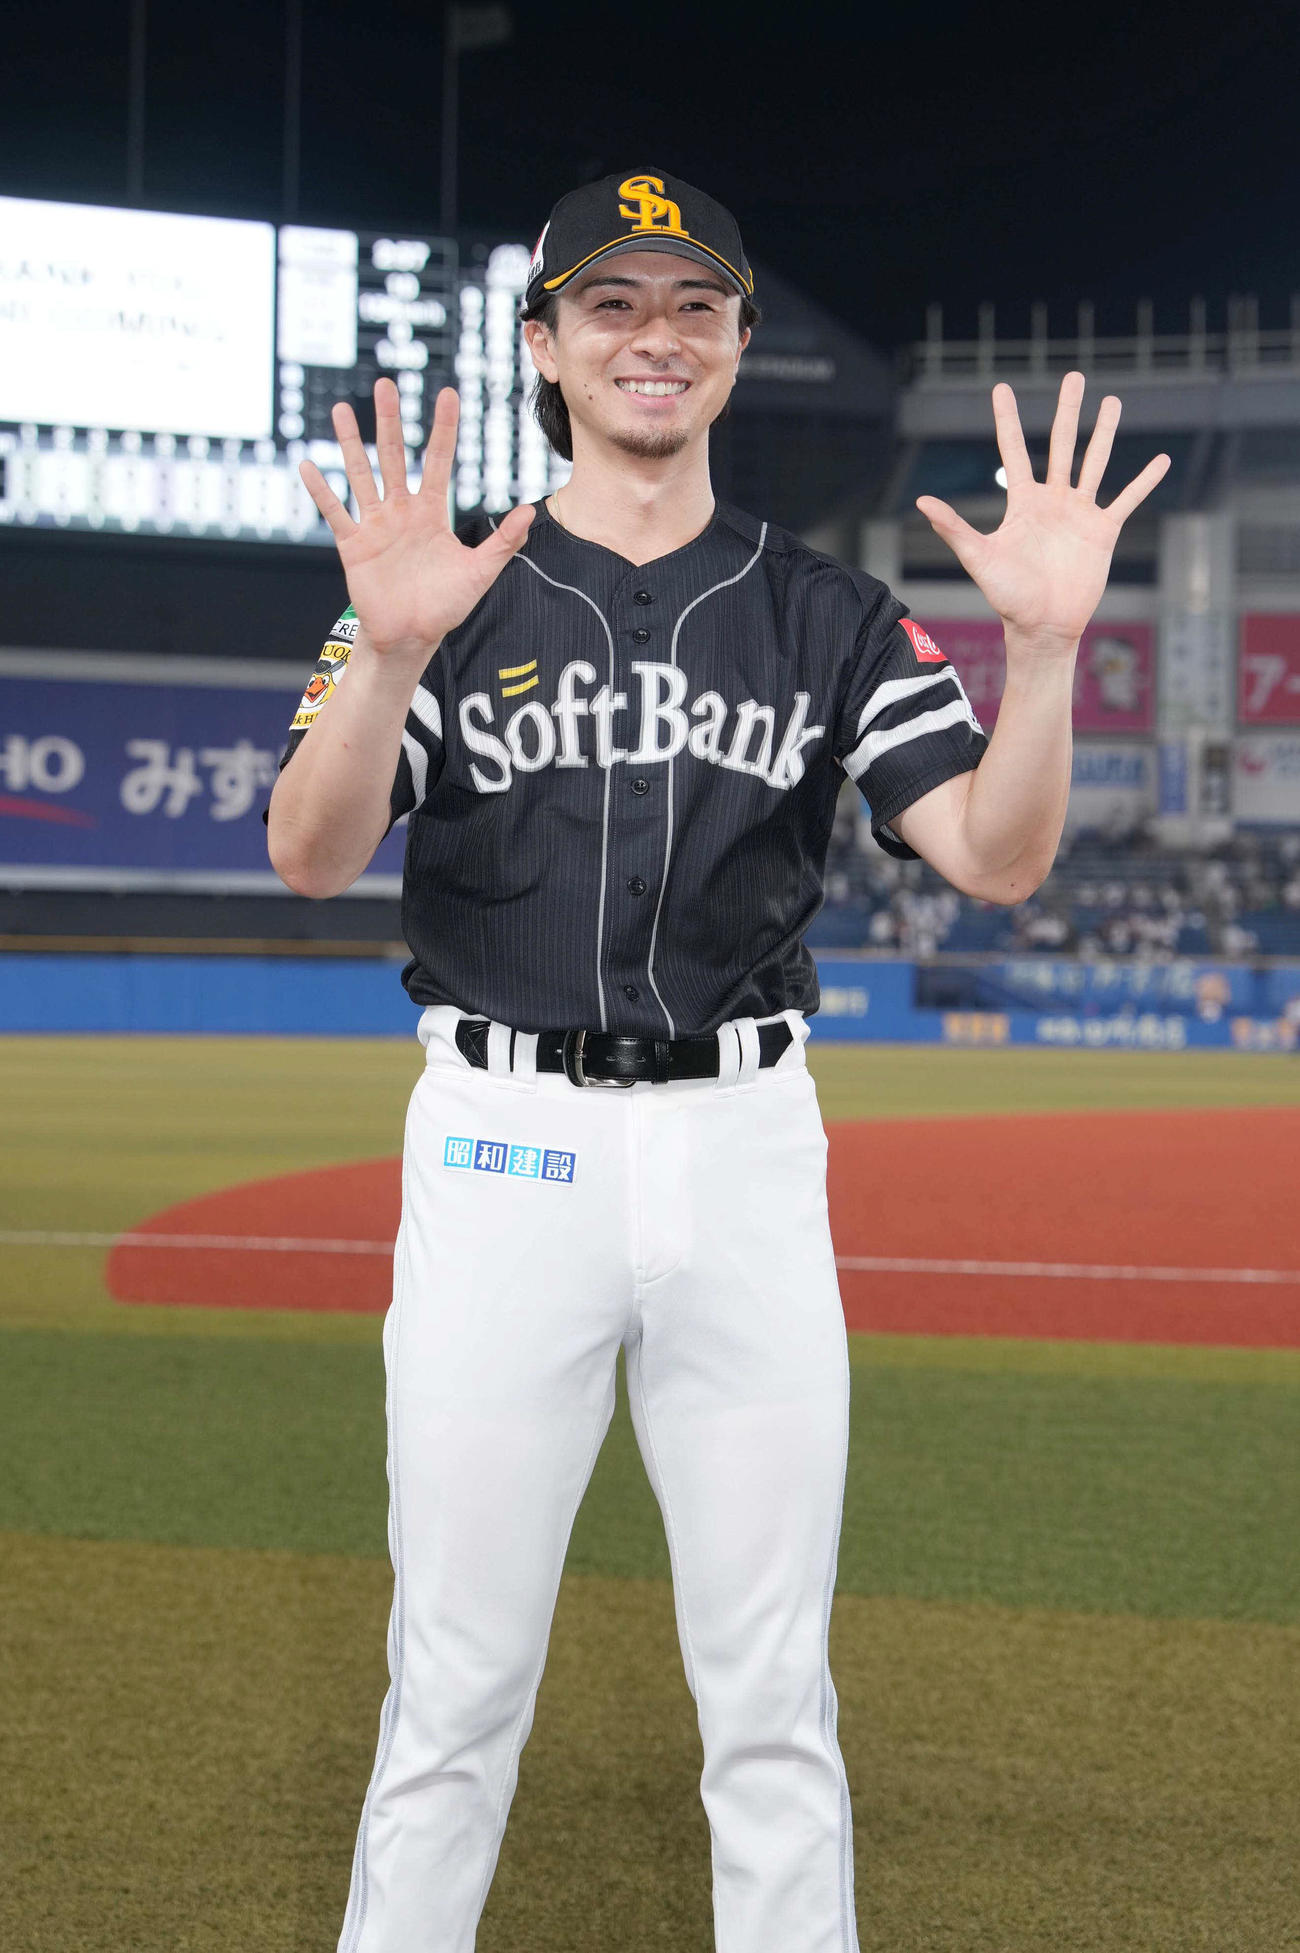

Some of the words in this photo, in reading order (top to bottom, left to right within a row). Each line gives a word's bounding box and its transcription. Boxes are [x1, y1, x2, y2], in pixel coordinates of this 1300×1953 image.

[458, 660, 826, 794] SoftBank
[120, 738, 287, 822] みず
[445, 1138, 573, 1181] 昭和建設
